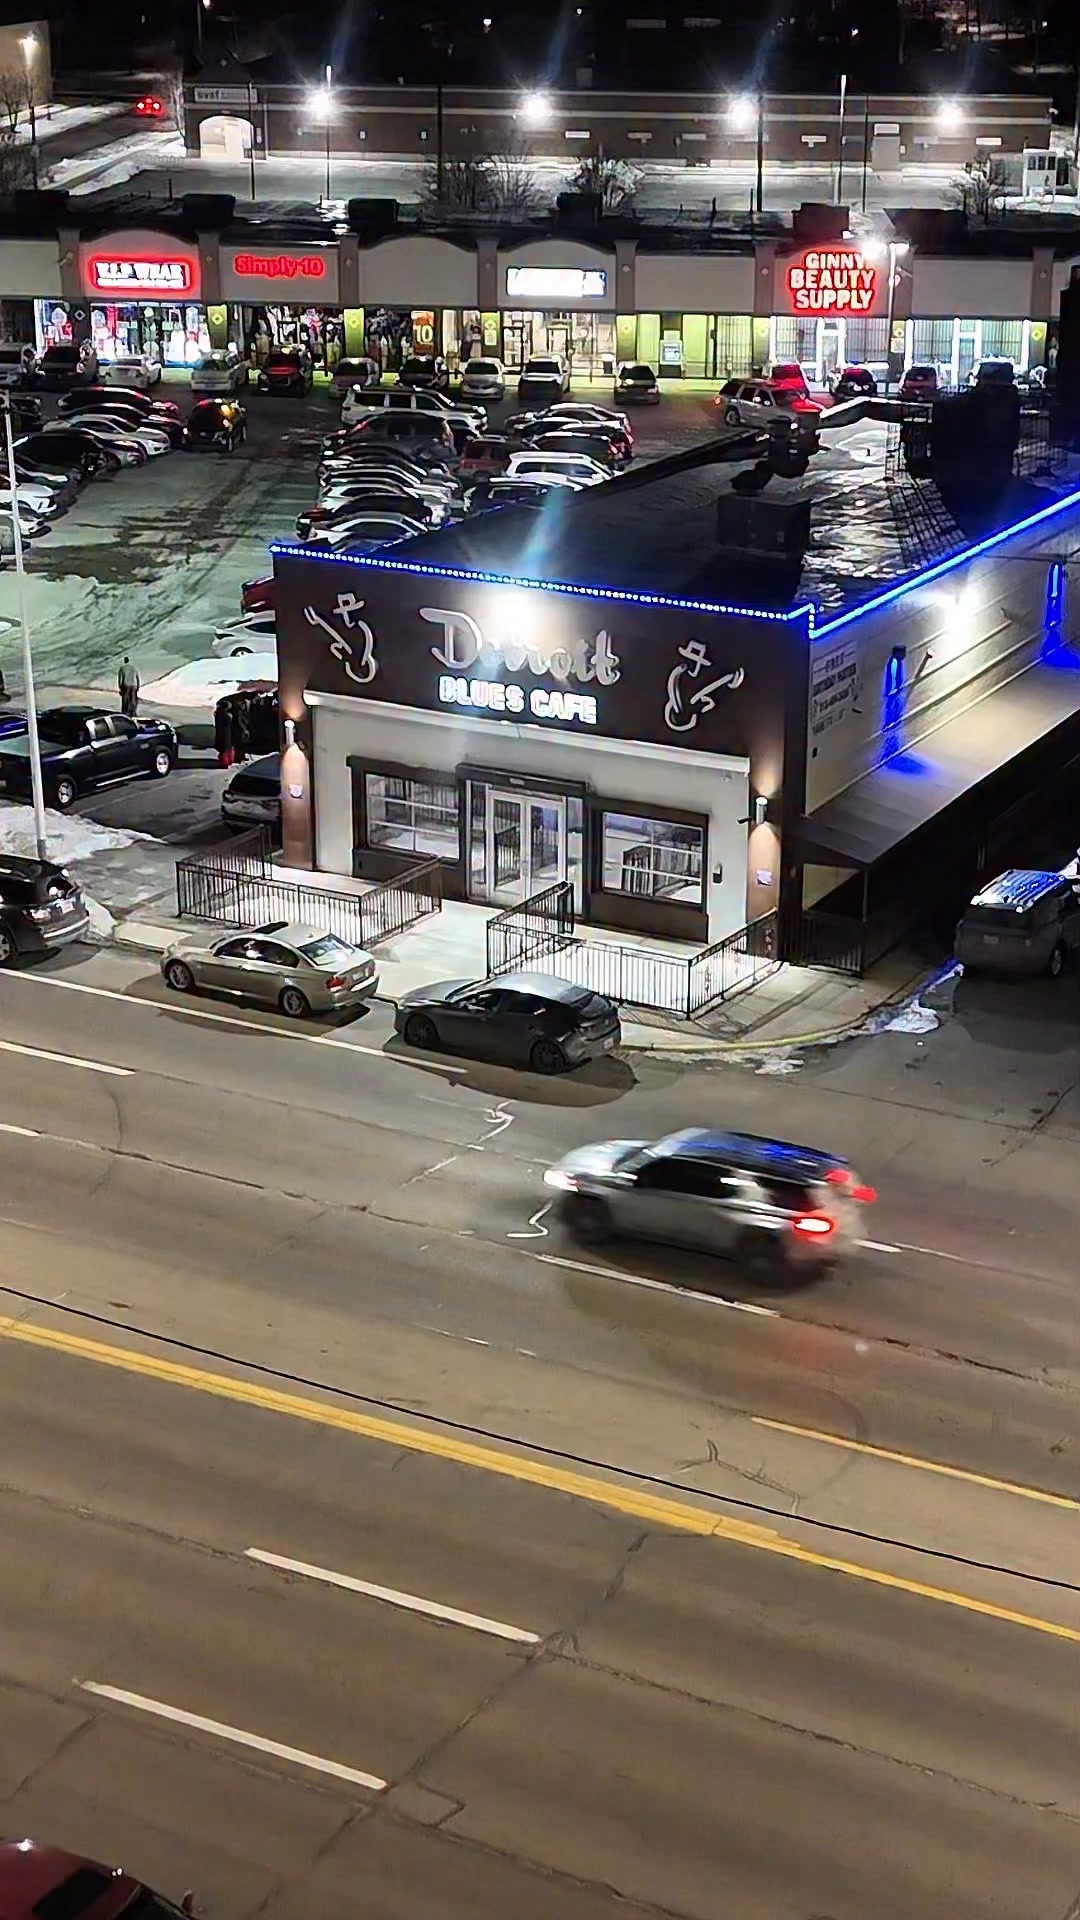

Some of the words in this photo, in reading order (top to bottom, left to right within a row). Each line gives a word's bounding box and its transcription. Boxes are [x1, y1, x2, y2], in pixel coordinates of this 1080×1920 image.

[236, 256, 297, 277] Simply
[301, 258, 323, 275] 10
[805, 253, 866, 269] GINNY
[790, 269, 875, 289] BEAUTY
[796, 289, 873, 309] SUPPLY
[420, 608, 620, 685] Droit
[439, 676, 525, 713] BLUES
[530, 689, 597, 724] CAFE
